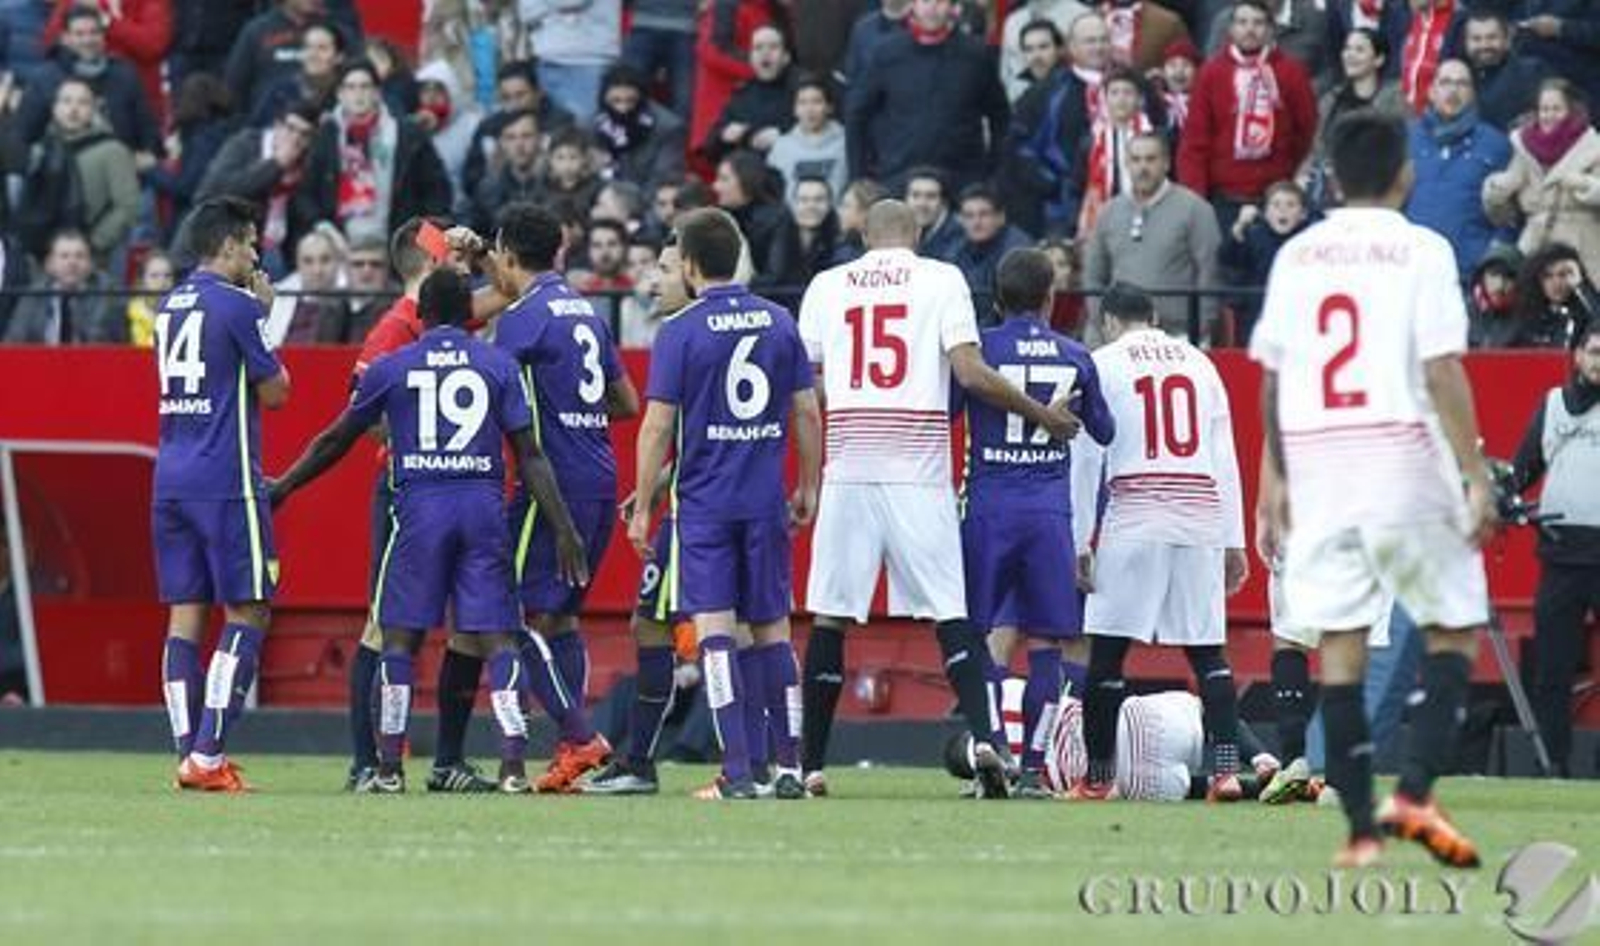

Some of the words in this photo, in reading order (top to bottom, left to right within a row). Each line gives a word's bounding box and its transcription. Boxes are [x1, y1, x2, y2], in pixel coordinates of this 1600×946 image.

[154, 310, 206, 394] 14
[707, 310, 772, 331] CAMACHO
[844, 304, 908, 389] 15
[1016, 340, 1060, 357] DUDA
[1318, 294, 1368, 408] 2
[573, 324, 604, 403] 3
[726, 335, 770, 420] 6
[999, 364, 1077, 445] 17
[407, 368, 489, 451] 19
[1134, 374, 1199, 459] 10
[641, 563, 660, 595] 9
